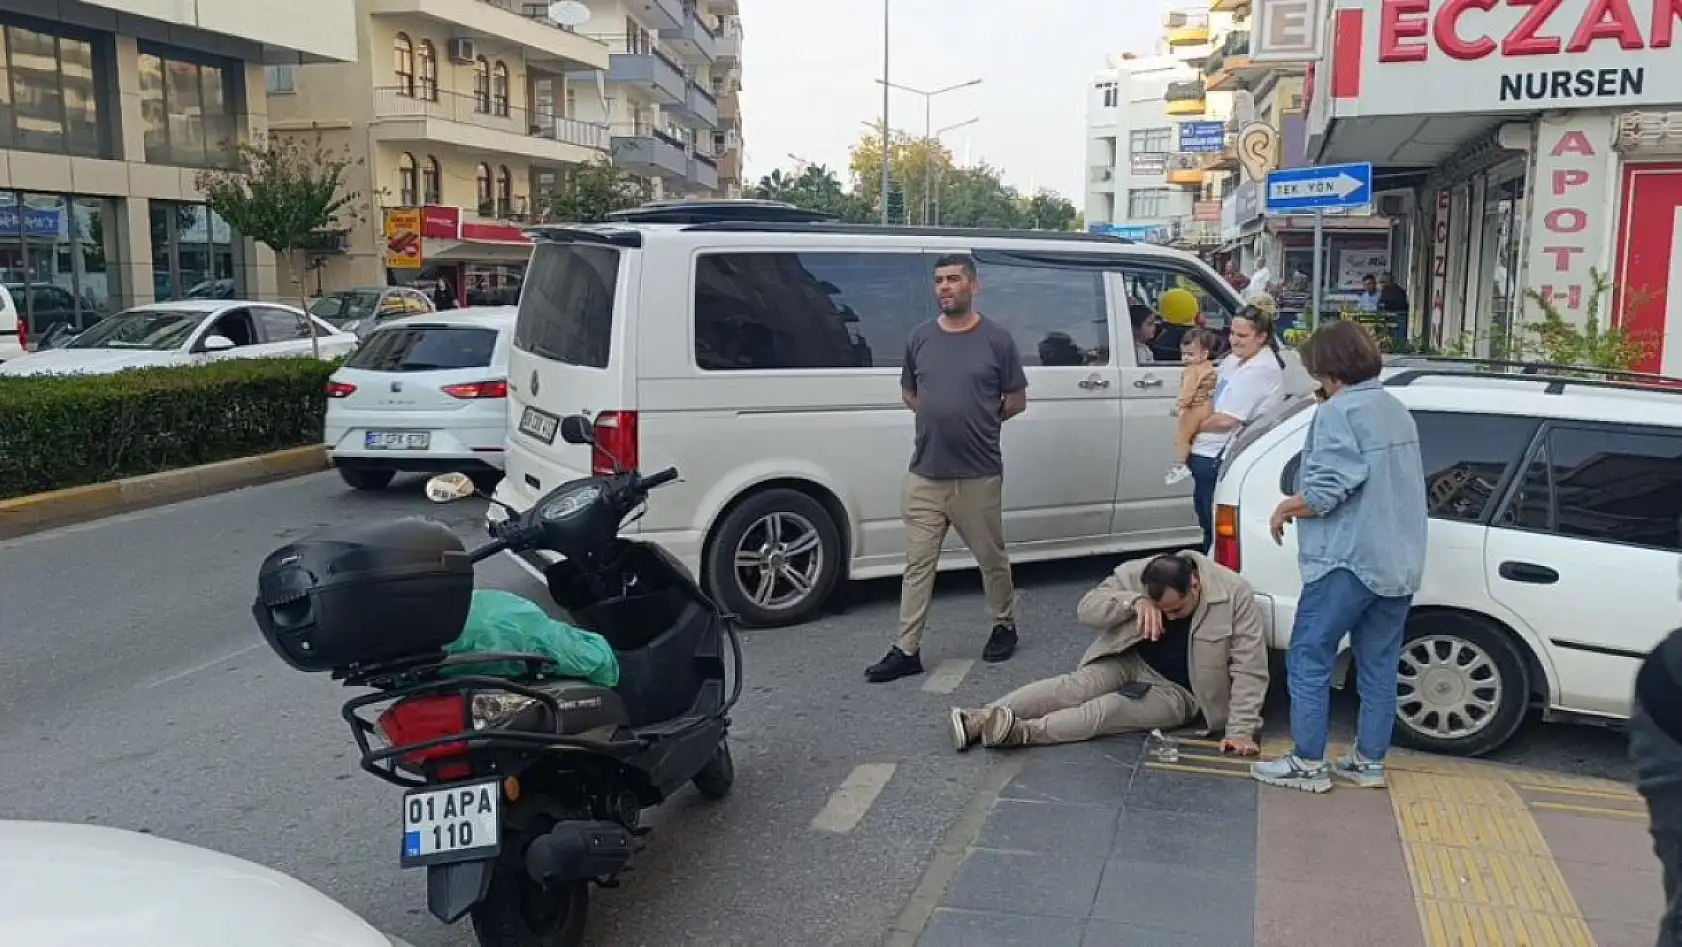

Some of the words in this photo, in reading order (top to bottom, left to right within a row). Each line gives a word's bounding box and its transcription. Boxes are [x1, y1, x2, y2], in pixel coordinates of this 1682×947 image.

[1269, 2, 1307, 46] E
[1500, 67, 1644, 101] NURSEN
[1276, 184, 1298, 195] TEK
[1540, 131, 1595, 328] APOTH
[410, 796, 435, 824] 01
[444, 788, 492, 819] APA
[434, 821, 473, 849] 110
